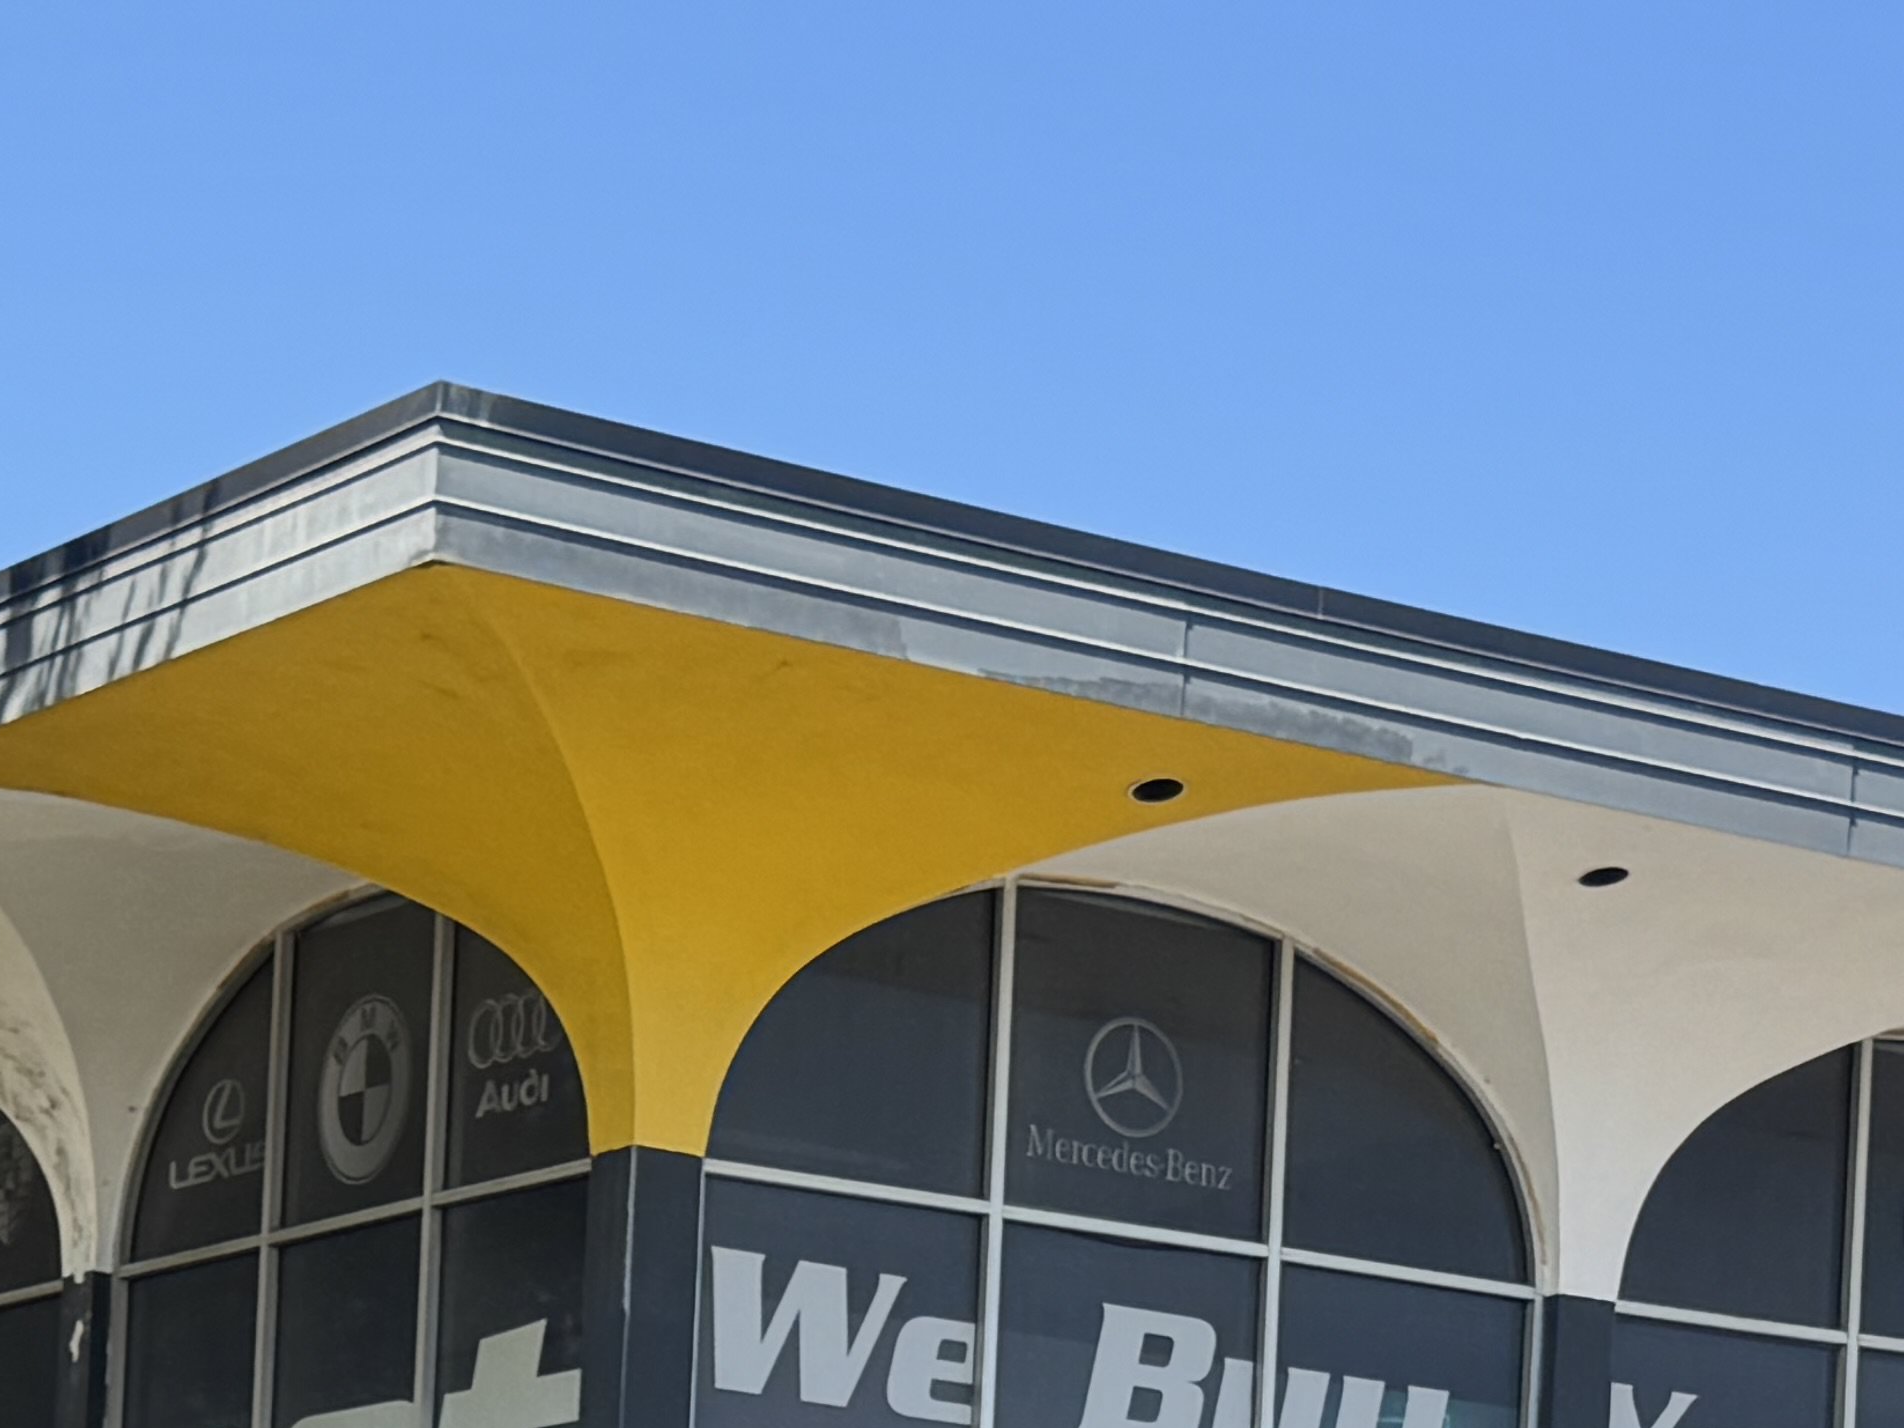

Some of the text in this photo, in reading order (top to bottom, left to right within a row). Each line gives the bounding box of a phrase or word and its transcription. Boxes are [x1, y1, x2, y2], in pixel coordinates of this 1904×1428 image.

[474, 1067, 551, 1120] Audi
[1026, 1122, 1234, 1192] Mercedes-Benz
[711, 1245, 976, 1425] We
